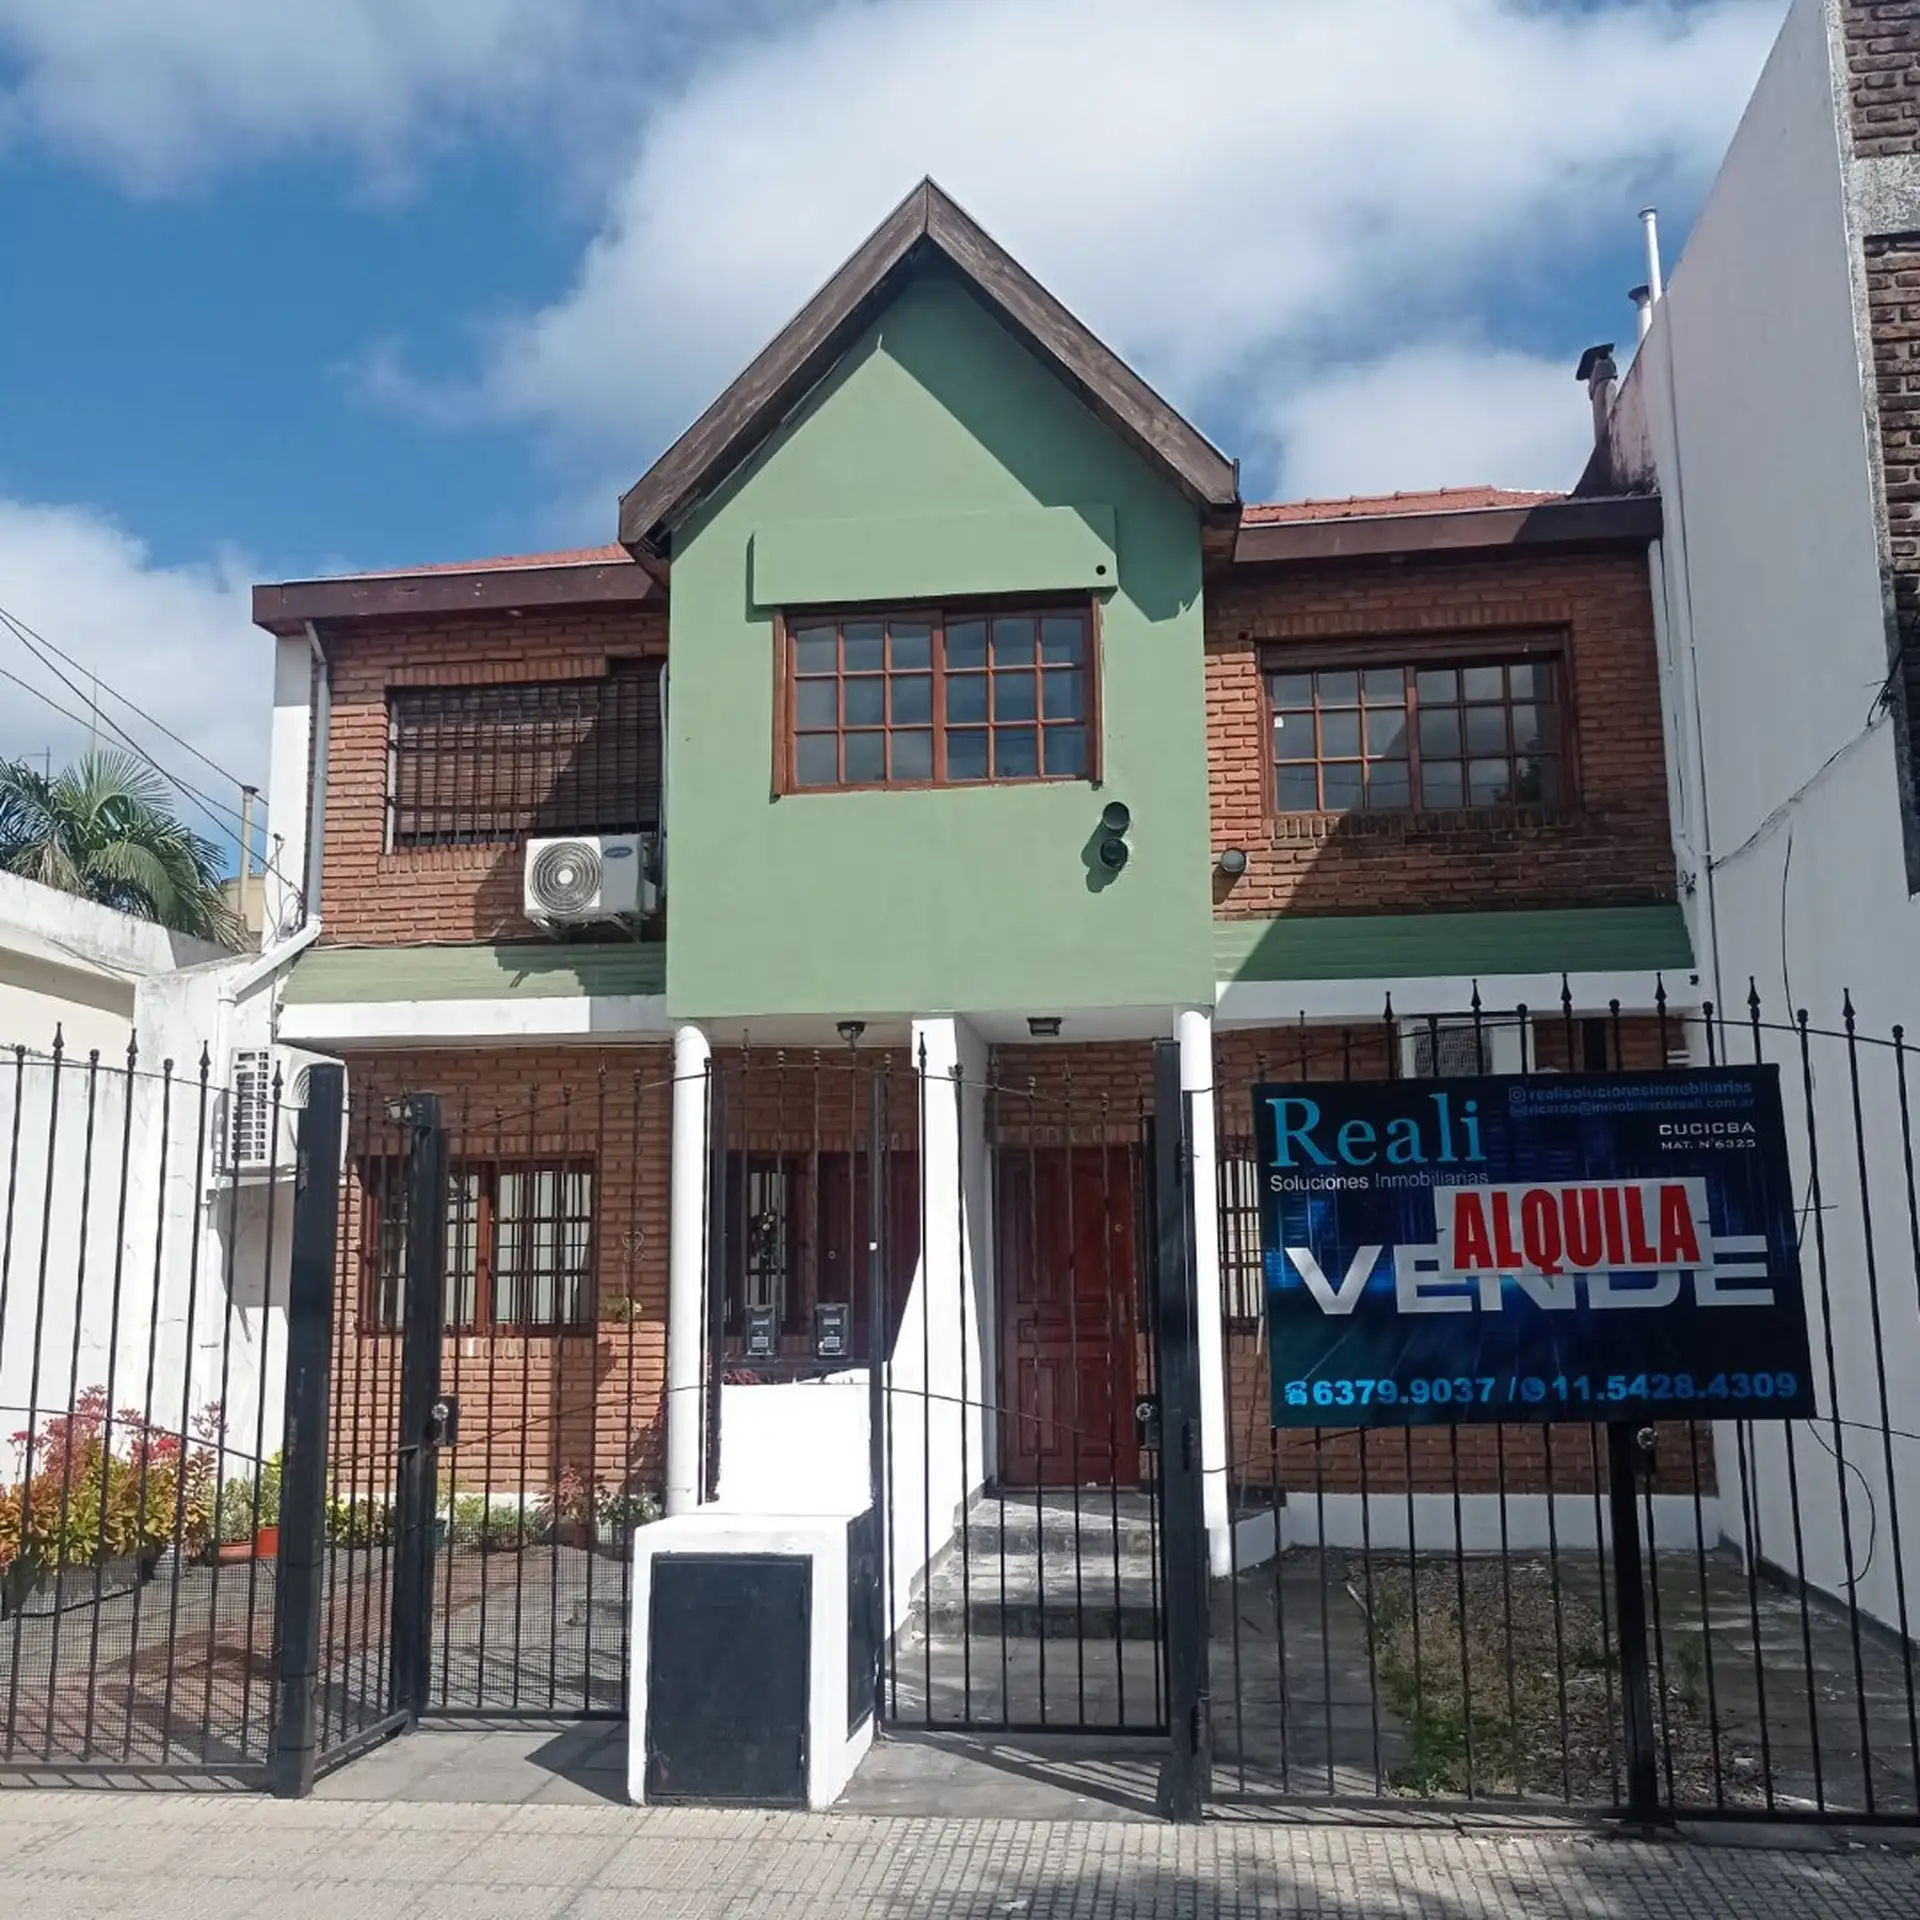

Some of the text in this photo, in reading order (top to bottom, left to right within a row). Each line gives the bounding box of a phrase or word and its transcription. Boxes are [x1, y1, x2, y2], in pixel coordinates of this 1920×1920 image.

[1265, 1093, 1488, 1167] Reali
[1659, 1121, 1756, 1135] CUCICBA
[1661, 1141, 1694, 1151] MAT.
[1270, 1169, 1489, 1192] Soluciones Inmobiliarias
[1453, 1184, 1702, 1275] ALQUILA
[1312, 1377, 1496, 1405] 6379.9037
[1552, 1372, 1799, 1401] 11.5428.4309
